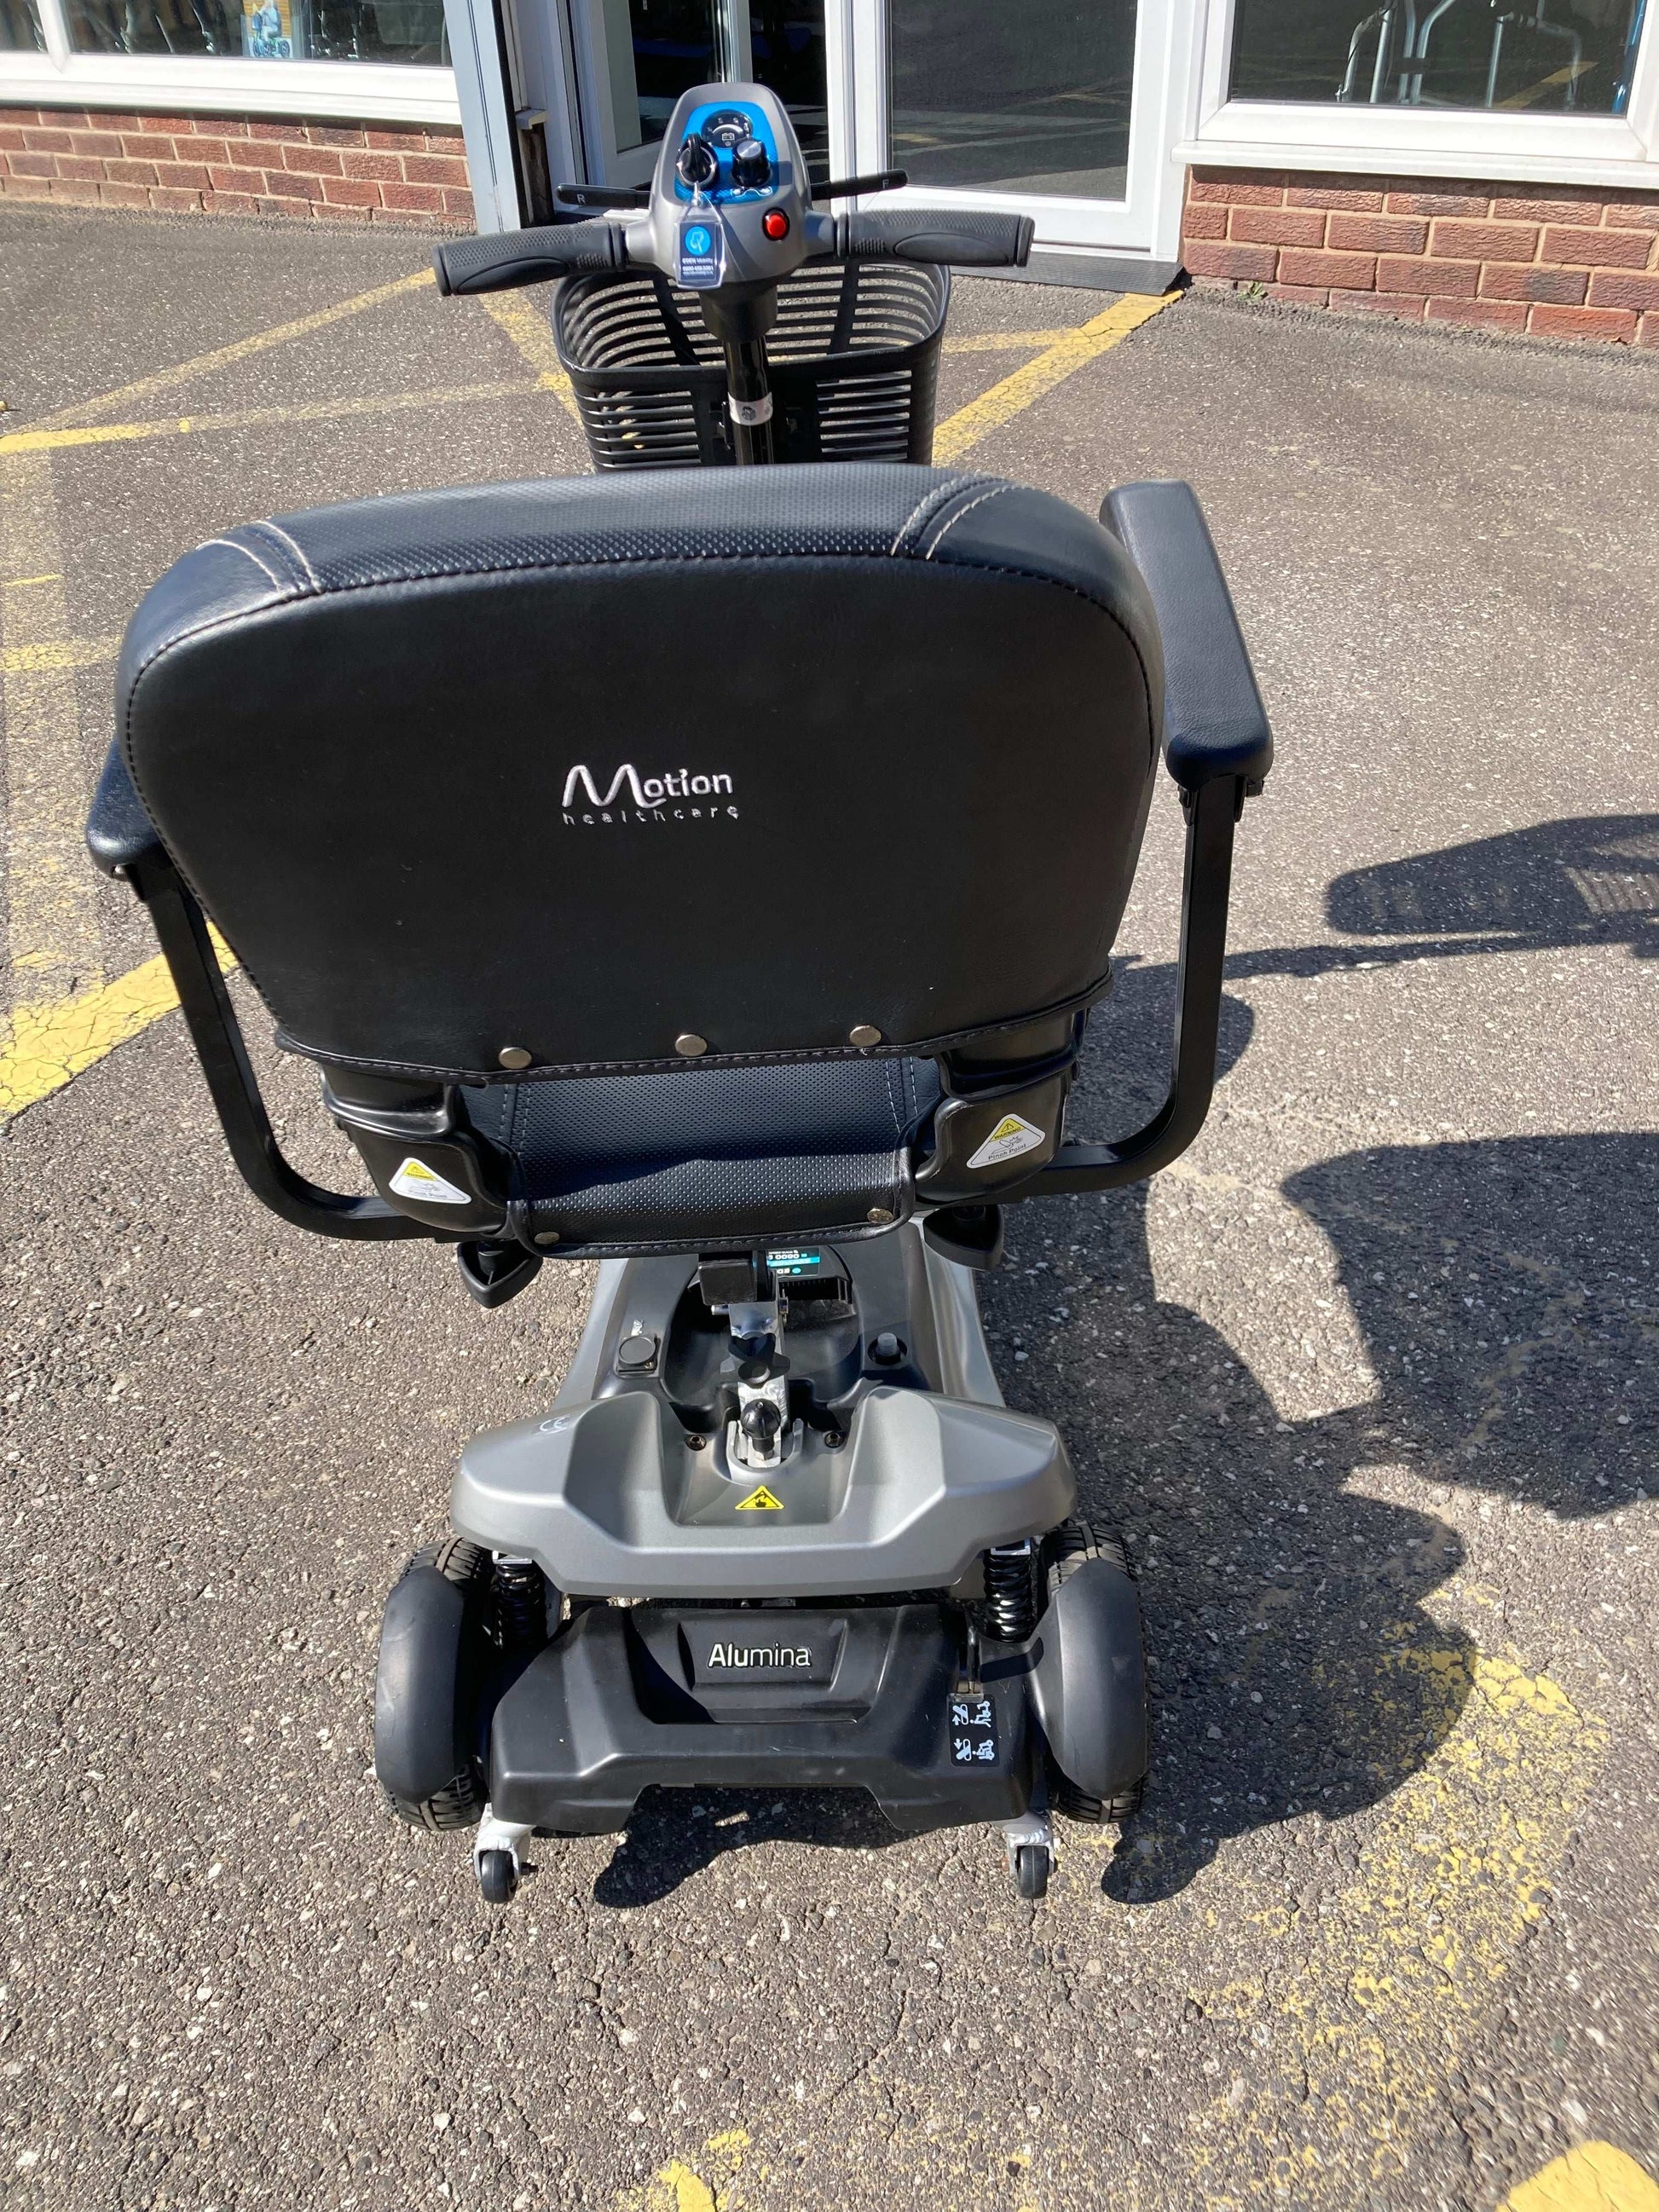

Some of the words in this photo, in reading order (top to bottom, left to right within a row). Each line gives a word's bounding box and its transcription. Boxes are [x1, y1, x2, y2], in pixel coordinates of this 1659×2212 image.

[882, 179, 890, 189] F
[576, 193, 587, 205] R
[561, 764, 734, 809] Motion
[562, 806, 740, 825] healthcare
[994, 1126, 1022, 1140] WARNING
[988, 1150, 1008, 1160] Pinch
[1009, 1143, 1026, 1154] Point
[707, 1642, 811, 1667] Alumina
